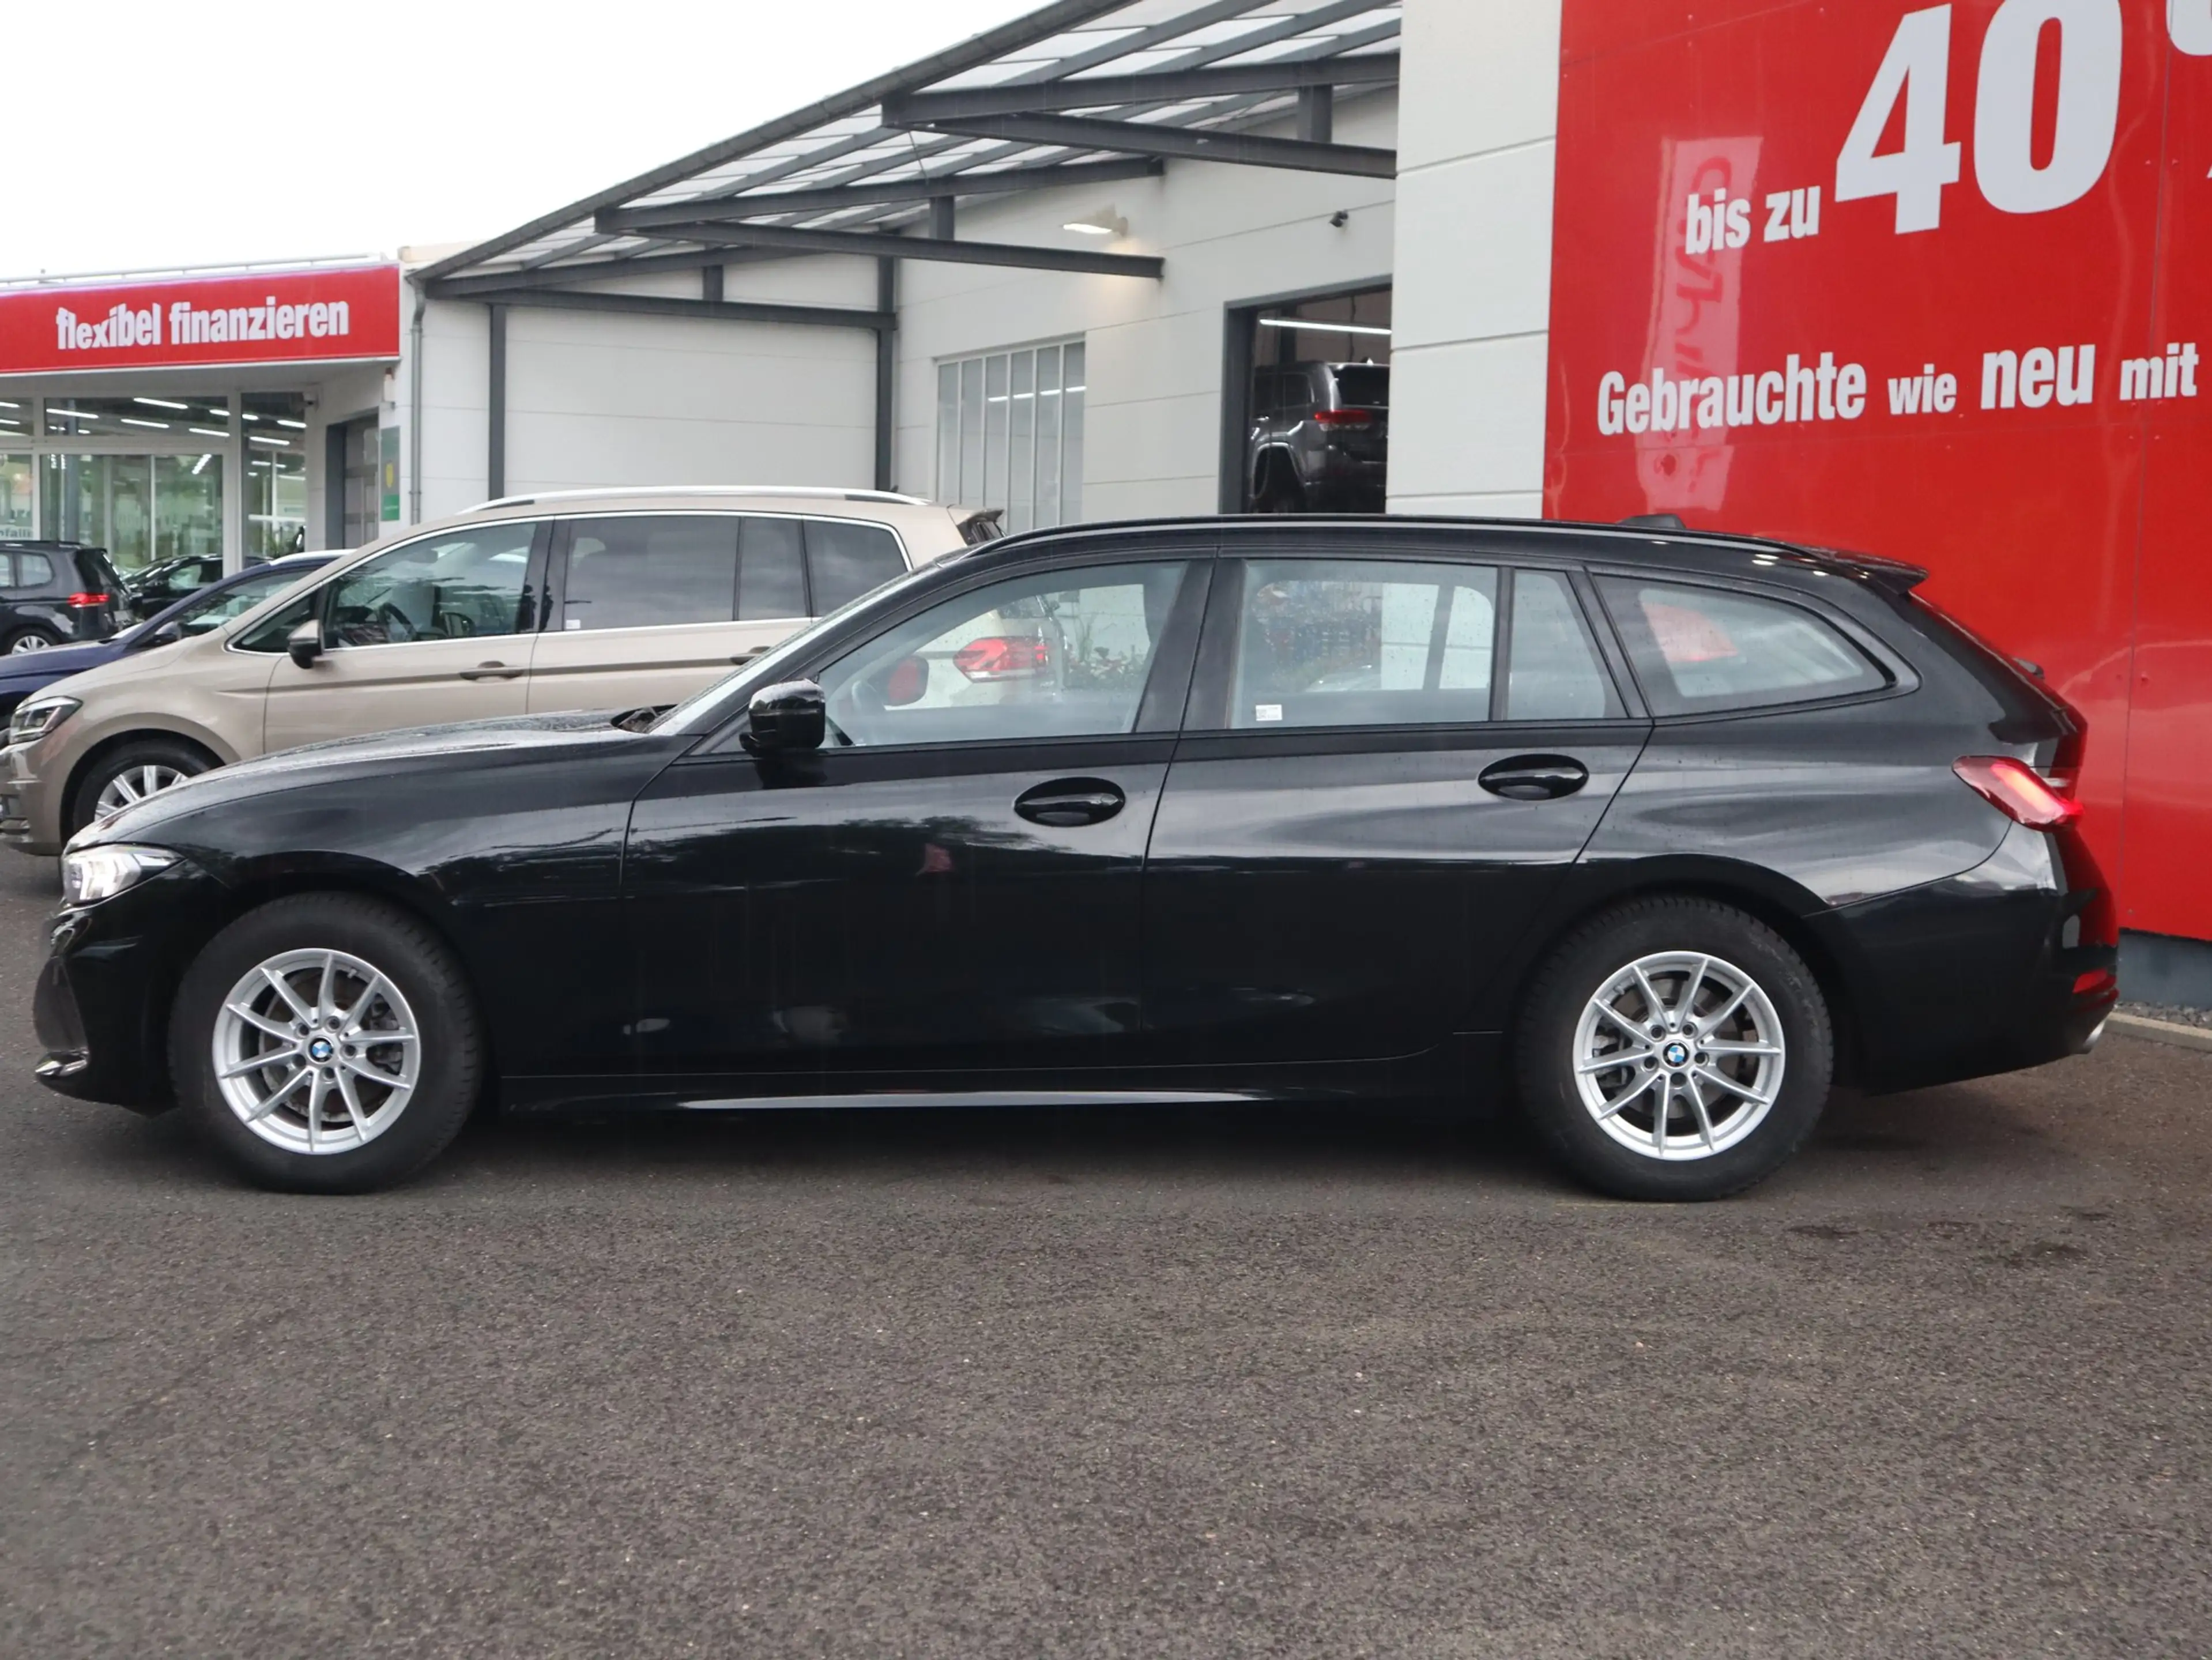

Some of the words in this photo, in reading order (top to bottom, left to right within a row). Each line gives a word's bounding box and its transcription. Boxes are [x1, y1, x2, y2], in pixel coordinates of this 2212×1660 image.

[1685, 188, 1751, 255] bis
[1763, 186, 1821, 242] zu
[55, 302, 162, 350] flexibel
[169, 296, 350, 345] finanzieren
[1597, 351, 1867, 436] Gebrauchte
[1887, 363, 1957, 415] wie
[1980, 344, 2096, 409] neu
[2119, 342, 2199, 401] mit
